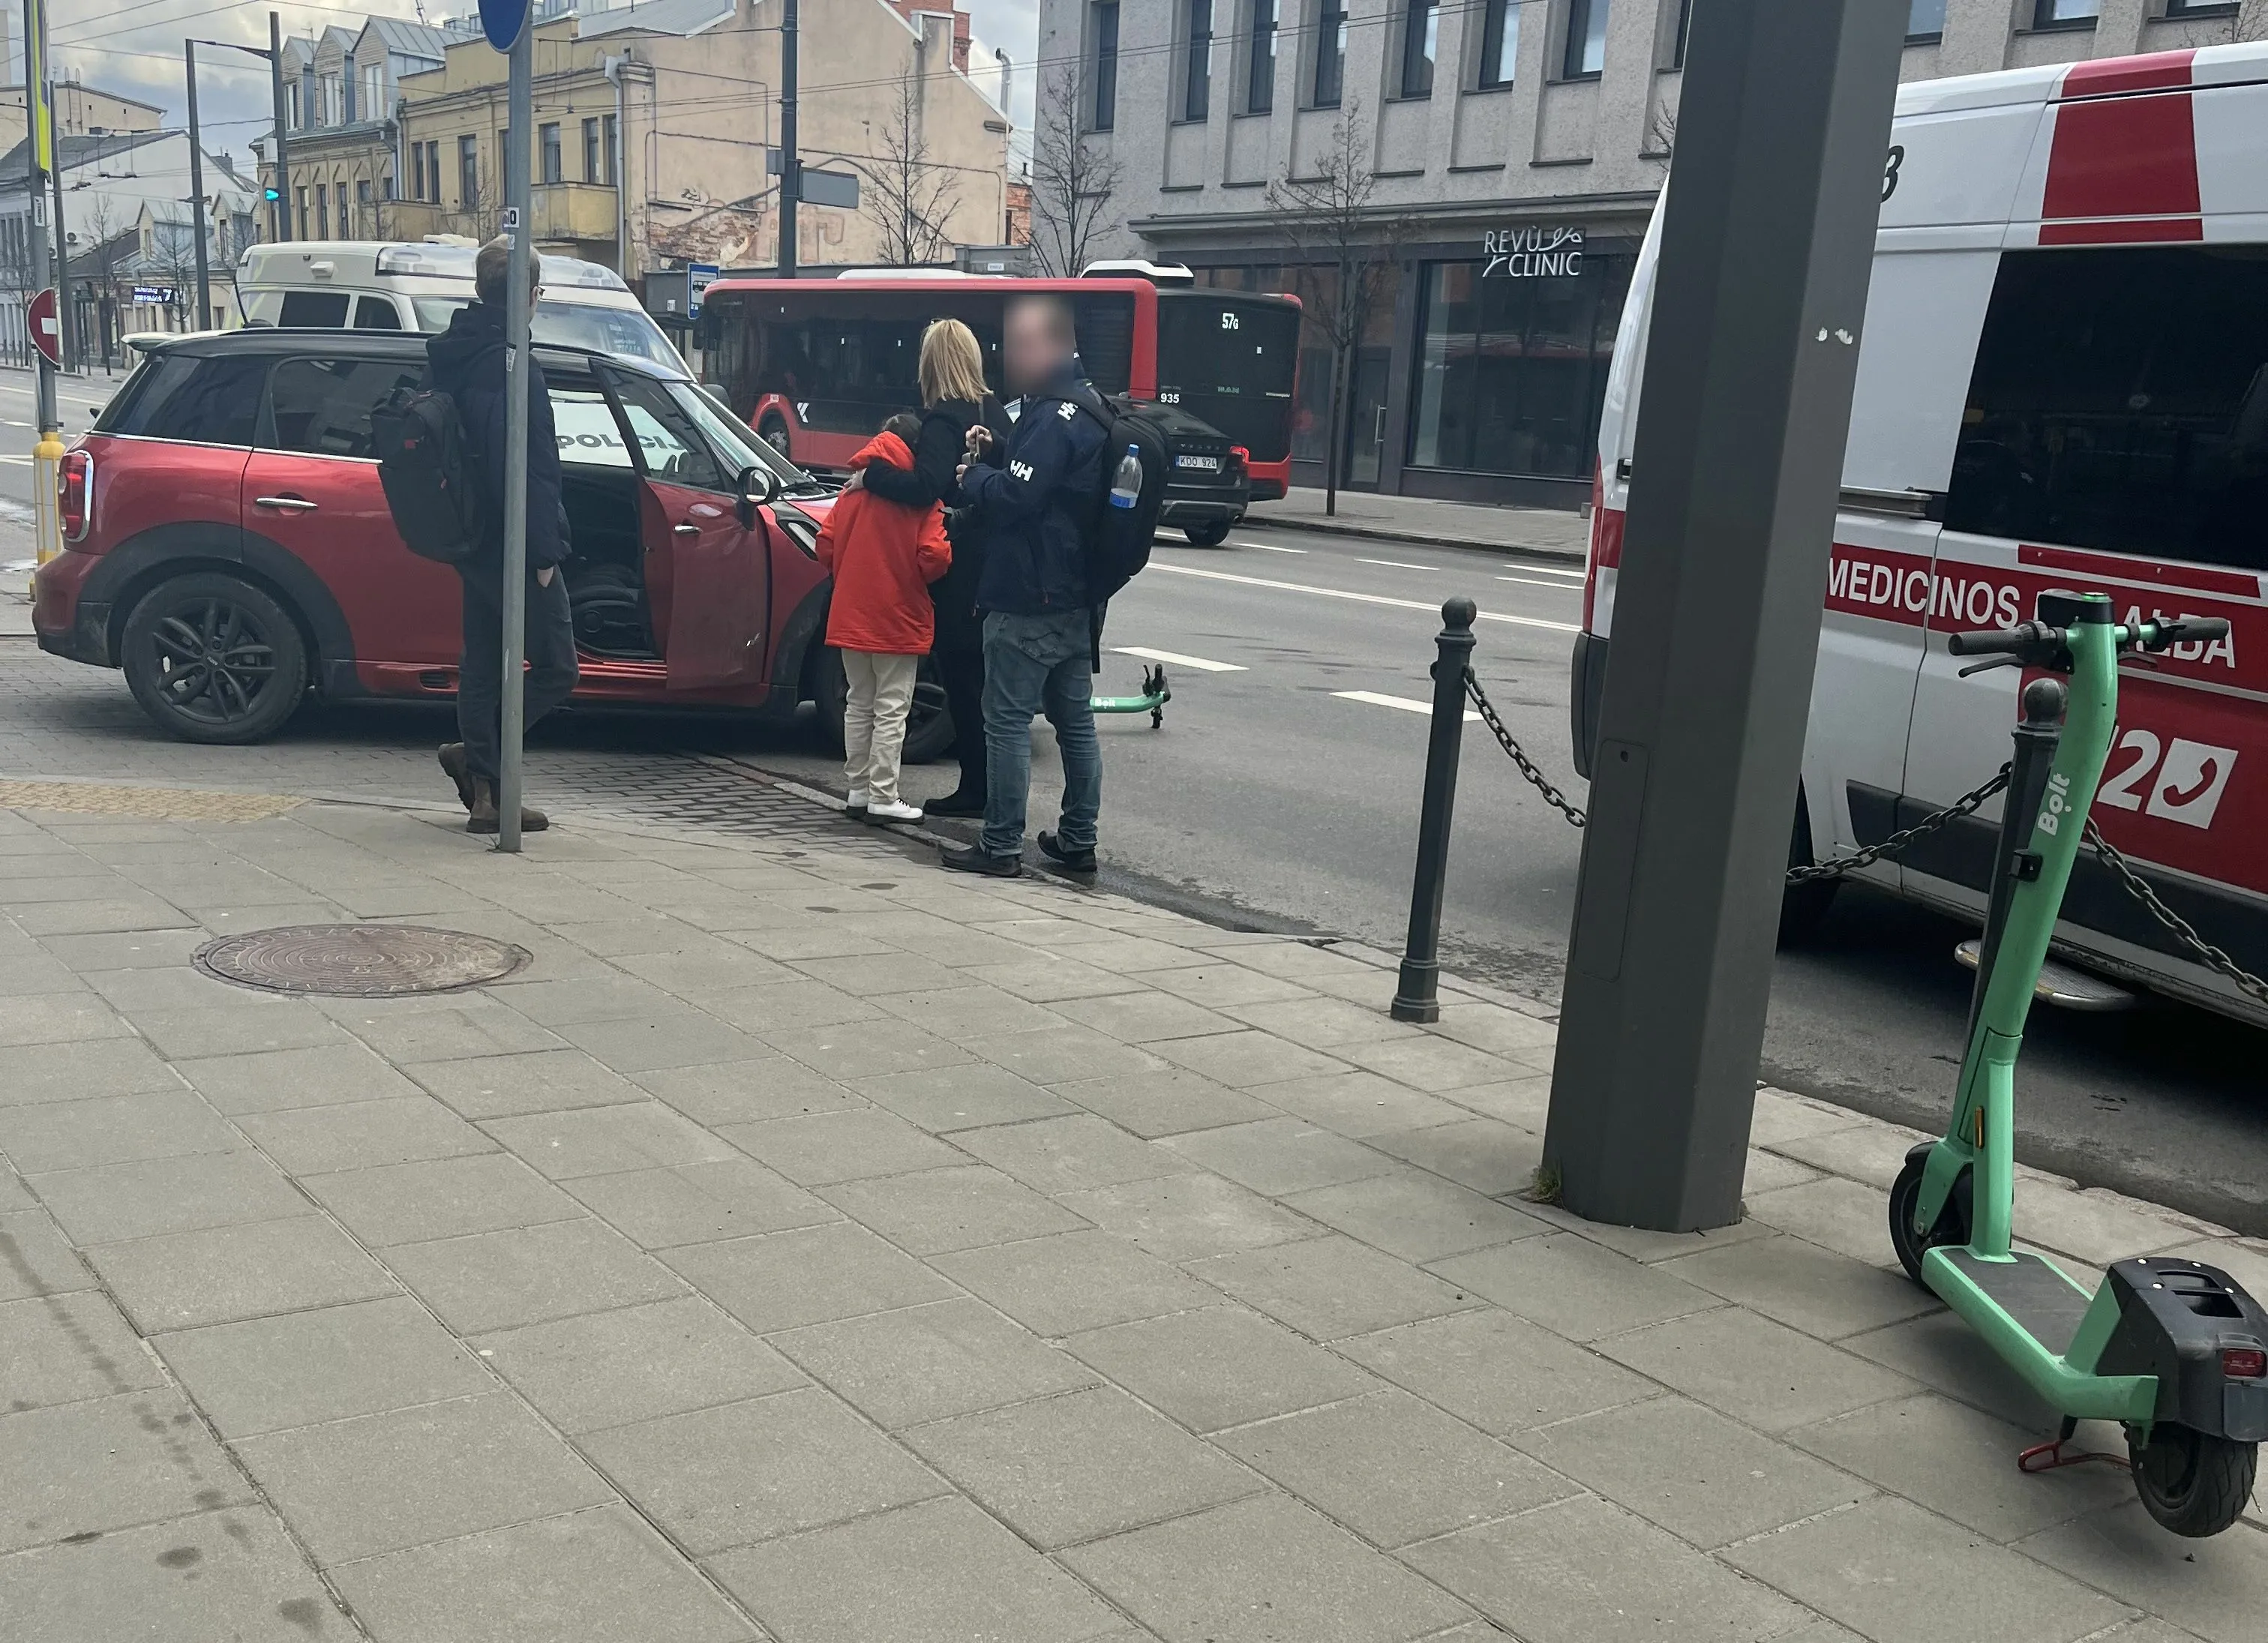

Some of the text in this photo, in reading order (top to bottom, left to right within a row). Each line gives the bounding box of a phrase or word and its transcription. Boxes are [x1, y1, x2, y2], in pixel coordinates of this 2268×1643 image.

[1509, 252, 1582, 277] CLINIC
[1160, 392, 1180, 403] 935
[1010, 460, 1034, 481] HH
[1828, 557, 2020, 629] MEDICINOS
[2037, 772, 2072, 836] Bolt
